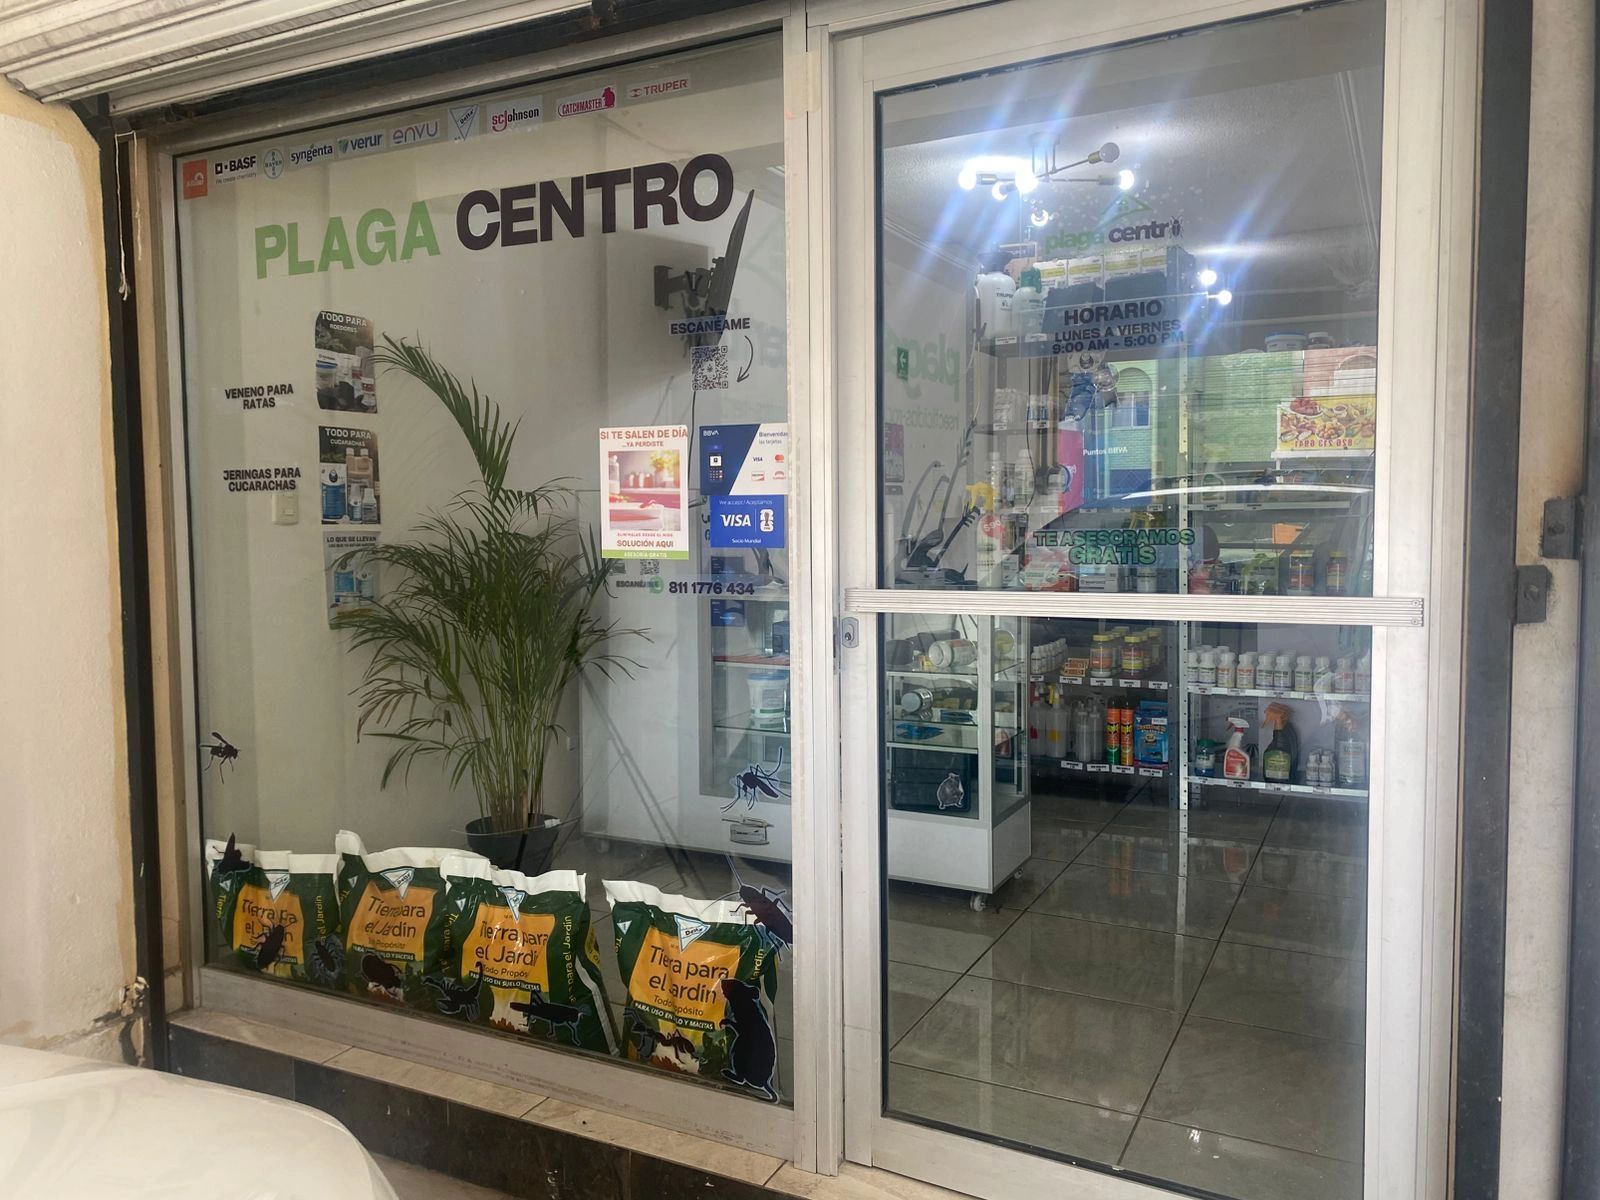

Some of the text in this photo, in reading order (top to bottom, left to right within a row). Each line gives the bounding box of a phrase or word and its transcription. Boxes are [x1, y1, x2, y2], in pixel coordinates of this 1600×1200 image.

[643, 79, 688, 96] TRUPER
[562, 98, 603, 115] CATCHMASTER
[393, 120, 439, 144] envu
[350, 134, 383, 151] verur
[291, 144, 333, 165] syngenta
[230, 156, 256, 172] BASF
[254, 152, 735, 280] PLAGA CENTRO
[320, 311, 367, 327] TODO PARA
[1064, 300, 1162, 326] HORARIO
[1055, 327, 1101, 343] LUNES
[1104, 327, 1114, 338] A
[1117, 320, 1182, 337] VIERNES
[1052, 341, 1084, 354] 9:00
[1088, 339, 1109, 352] AM
[1124, 334, 1157, 347] 5:00
[1161, 331, 1184, 343] PM
[225, 384, 294, 399] VENENO PARA
[243, 397, 276, 409] RATAS
[325, 428, 372, 440] TODO PARA
[600, 426, 688, 440] SI TE SALEN DE DÍA
[330, 438, 366, 447] CUCARACHAS
[1083, 448, 1107, 456] Puntos
[224, 467, 301, 481] JERINGAS PARA
[228, 479, 297, 492] CUCARACHAS
[720, 514, 751, 527] VISA
[617, 539, 654, 548] SOLUCIÓN
[1033, 528, 1196, 547] TE ASESORAMOS
[1068, 545, 1157, 565] GRATIS
[668, 581, 755, 595] 811 1776 434
[242, 898, 275, 920] Tierra
[245, 921, 254, 936] el
[365, 920, 376, 934] el
[562, 915, 572, 949] Jardín
[685, 926, 703, 936] Delta
[475, 946, 489, 961] el
[685, 962, 730, 980] para
[649, 974, 717, 1004] el ardín
[653, 995, 672, 1007] Todo
[635, 1003, 650, 1013] PARA
[651, 1008, 664, 1017] USO
[665, 1012, 674, 1020] EN
